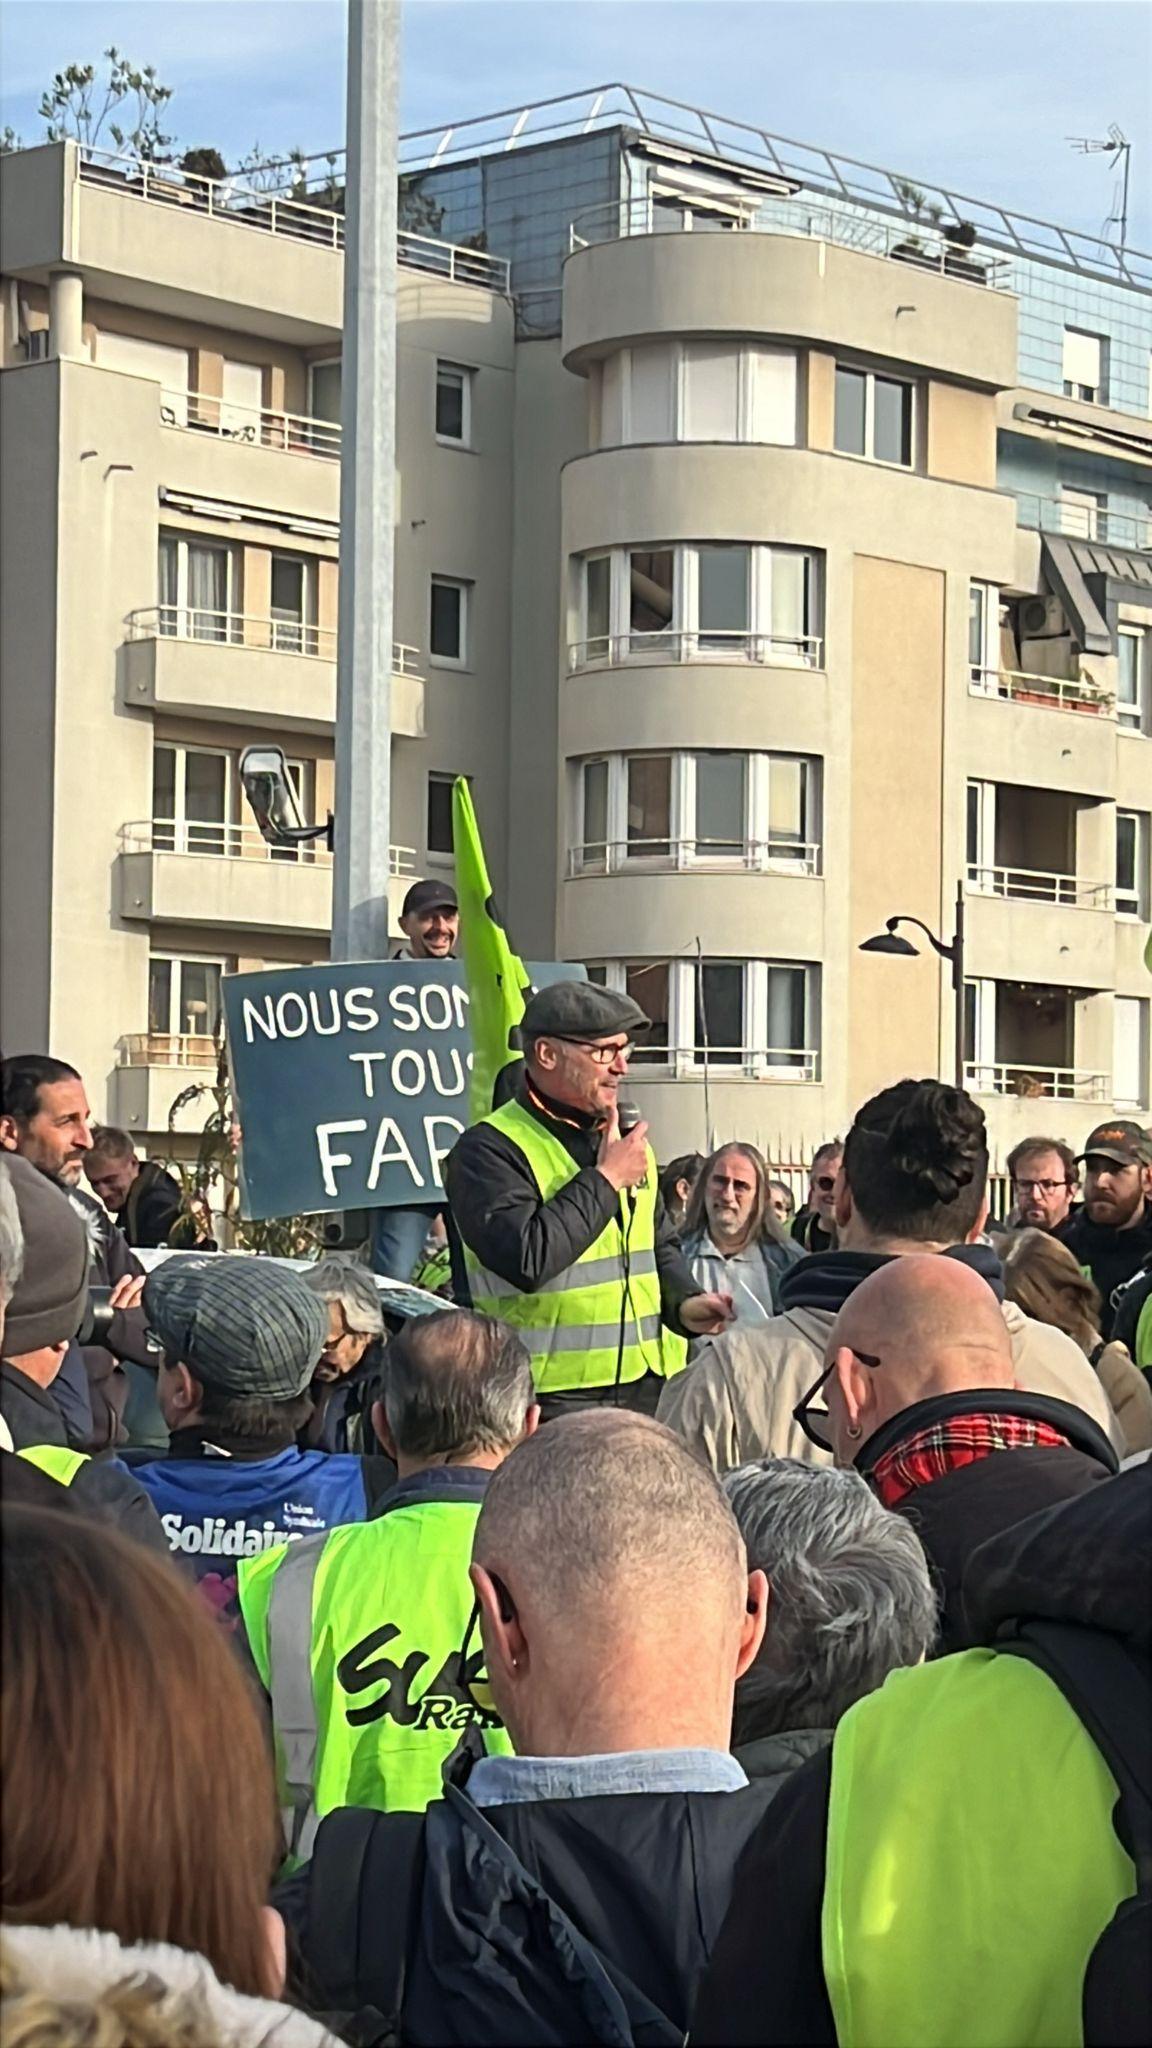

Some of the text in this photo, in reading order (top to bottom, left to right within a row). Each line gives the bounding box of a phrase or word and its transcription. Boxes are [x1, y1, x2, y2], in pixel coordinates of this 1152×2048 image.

[242, 986, 380, 1043] NOUS
[348, 1048, 473, 1098] TOU
[160, 1513, 304, 1556] Solidair
